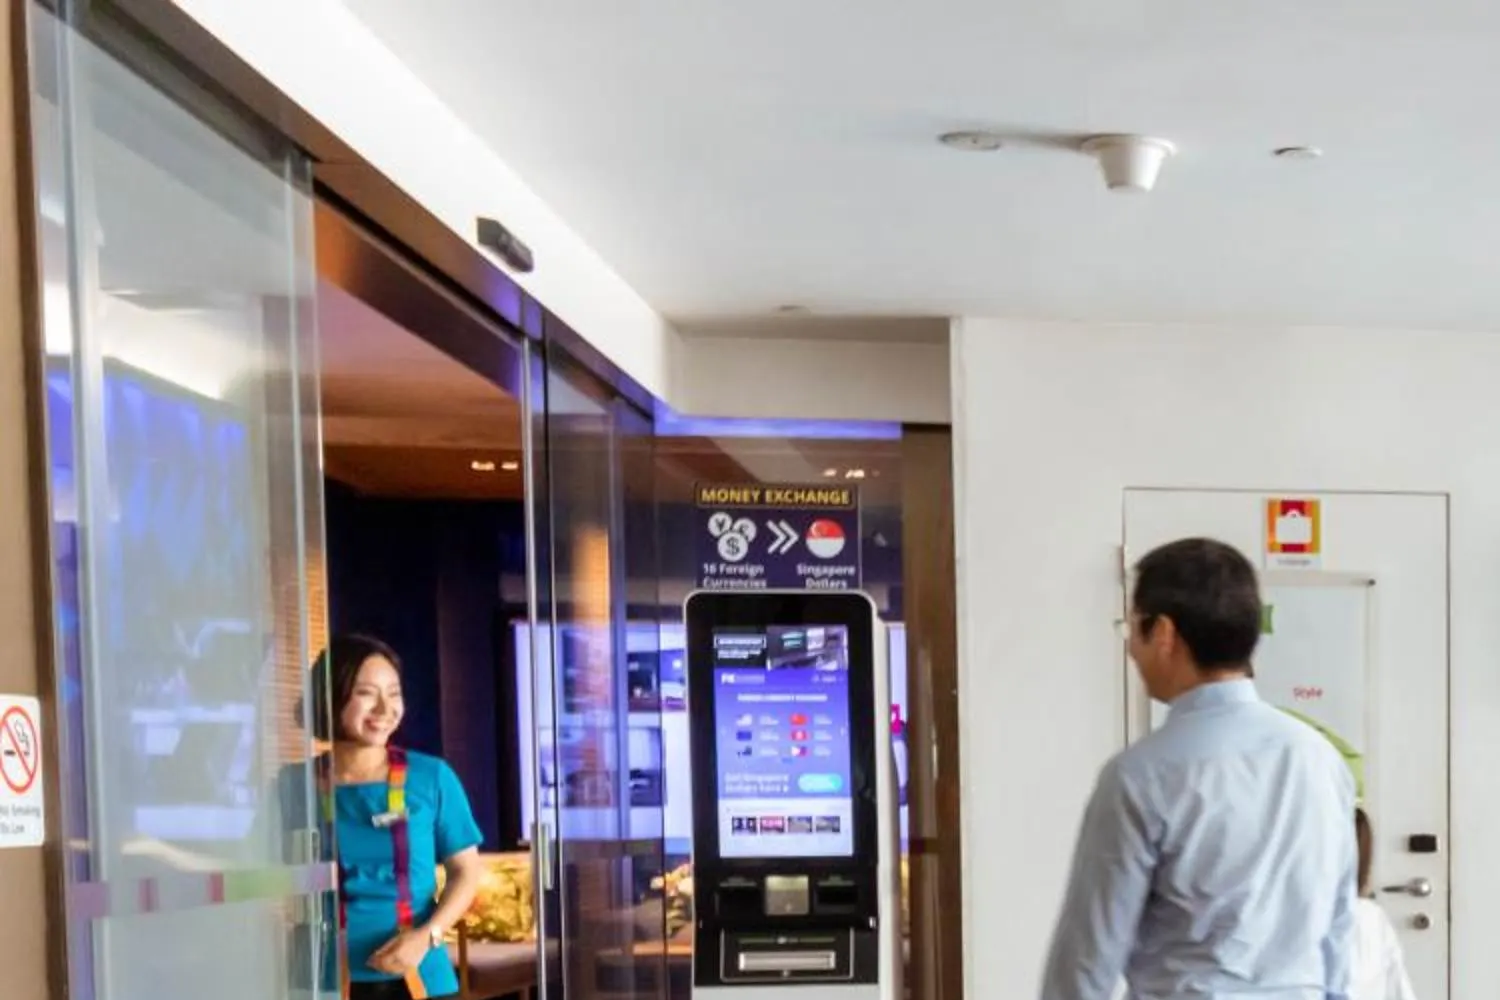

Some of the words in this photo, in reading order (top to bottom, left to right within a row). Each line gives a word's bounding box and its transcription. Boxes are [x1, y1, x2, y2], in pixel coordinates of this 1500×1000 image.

[701, 488, 761, 503] MONEY
[765, 488, 850, 505] EXCHANGE
[719, 563, 766, 577] Foreign
[796, 563, 856, 577] Singapore
[703, 576, 767, 589] Currencies
[805, 577, 848, 589] Dollars
